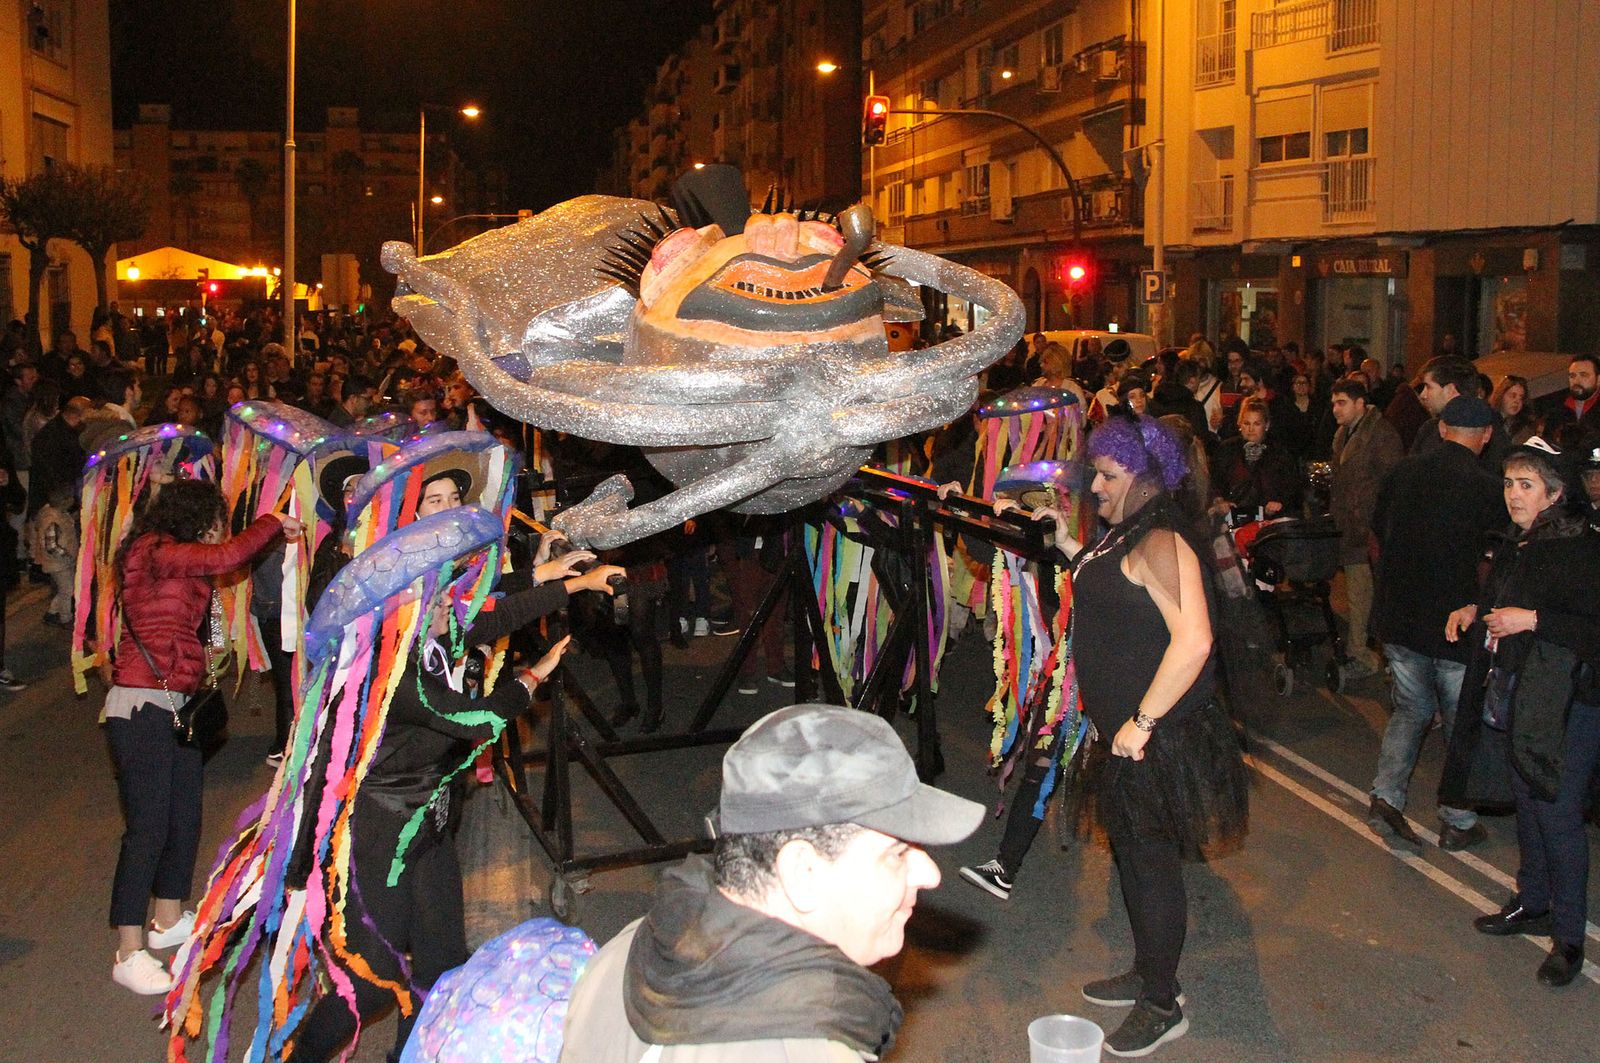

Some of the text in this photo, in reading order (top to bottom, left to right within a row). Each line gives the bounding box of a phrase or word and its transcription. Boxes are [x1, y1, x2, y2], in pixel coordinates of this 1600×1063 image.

[1333, 259, 1392, 273] CAJA RURAL
[1145, 274, 1160, 300] P
